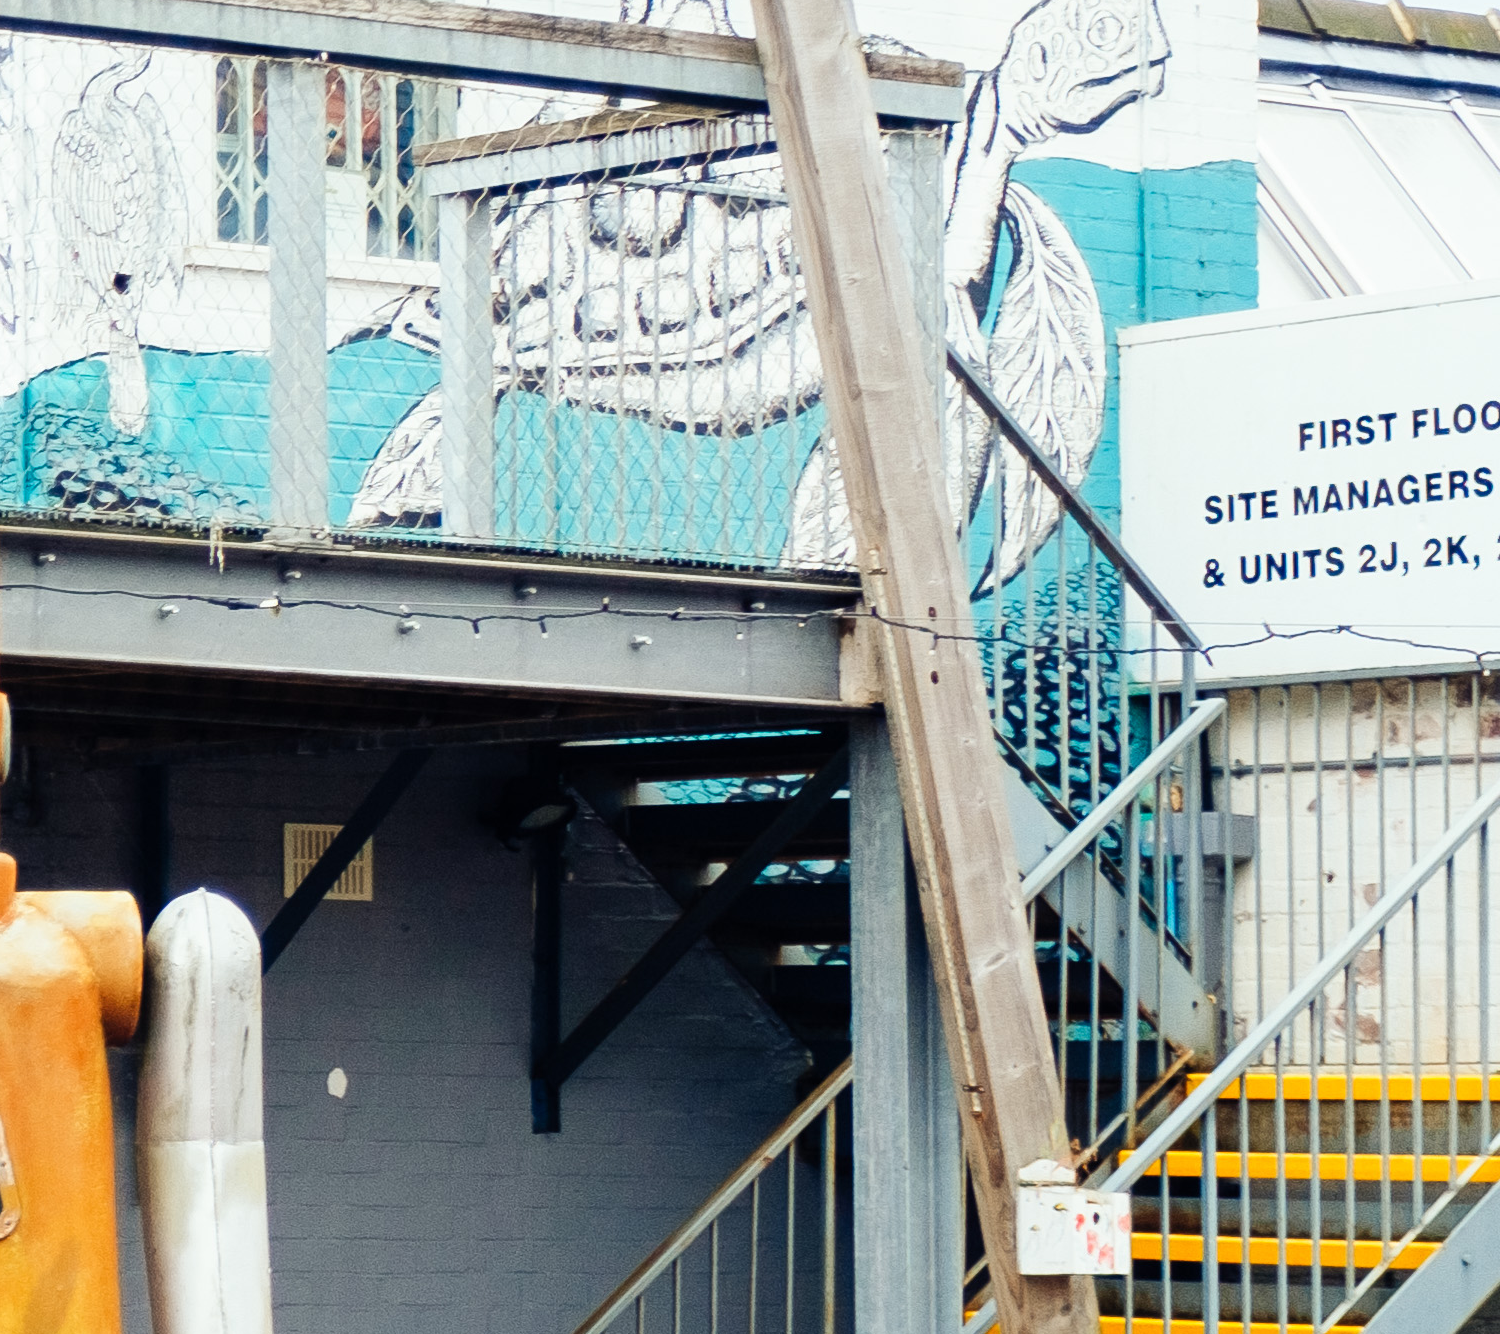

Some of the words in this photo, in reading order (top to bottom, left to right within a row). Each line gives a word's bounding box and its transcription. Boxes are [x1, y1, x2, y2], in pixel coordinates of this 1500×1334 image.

[1298, 411, 1398, 452] FIRST
[1204, 488, 1279, 525] SITE
[1292, 466, 1494, 517] MANAGERS
[1202, 558, 1226, 589] &
[1239, 546, 1345, 585] UNITS
[1358, 541, 1410, 577] 2J,
[1422, 534, 1481, 571] 2K,
